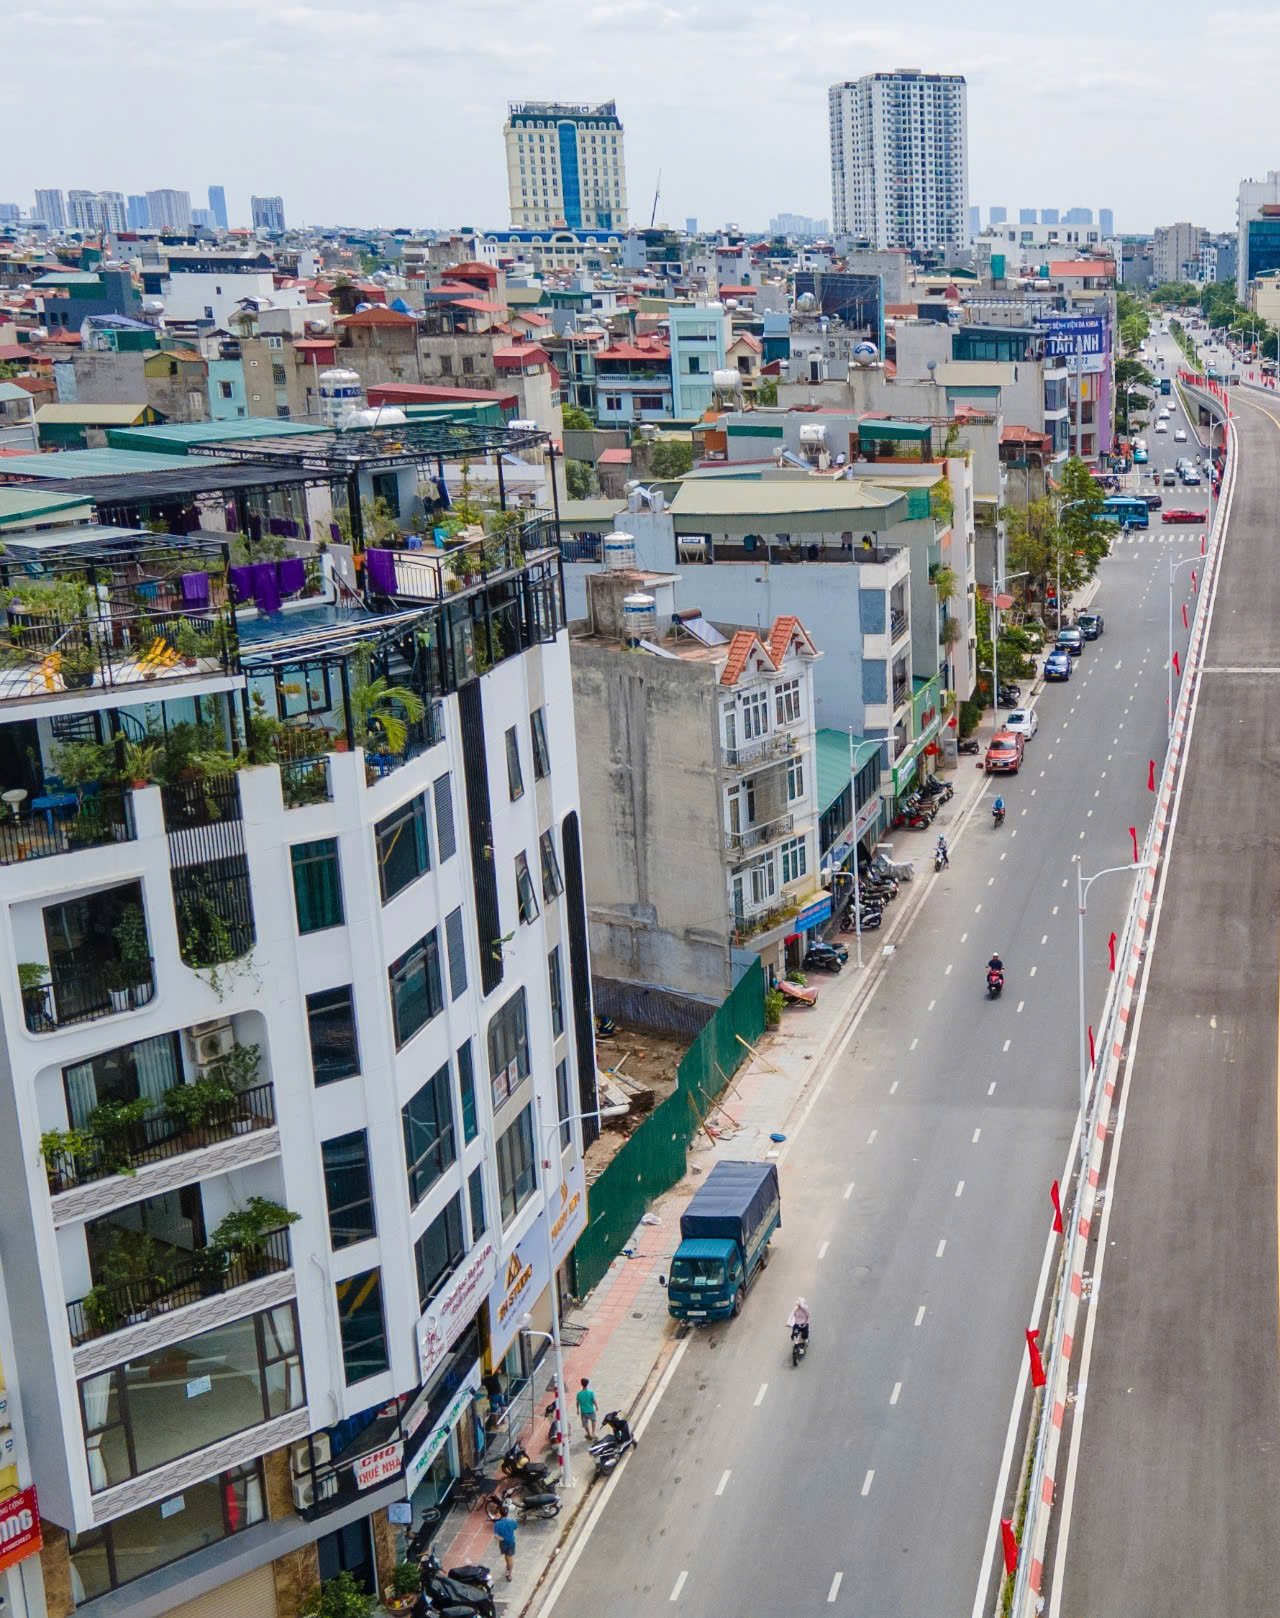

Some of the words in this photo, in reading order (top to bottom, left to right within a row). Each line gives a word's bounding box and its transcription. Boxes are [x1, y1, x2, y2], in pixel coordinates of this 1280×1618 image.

[1050, 332, 1074, 354] TÂM
[1075, 333, 1099, 353] ANH
[361, 1446, 396, 1468] CHO
[358, 1465, 380, 1484] THUÊ
[382, 1456, 401, 1474] NHÀ
